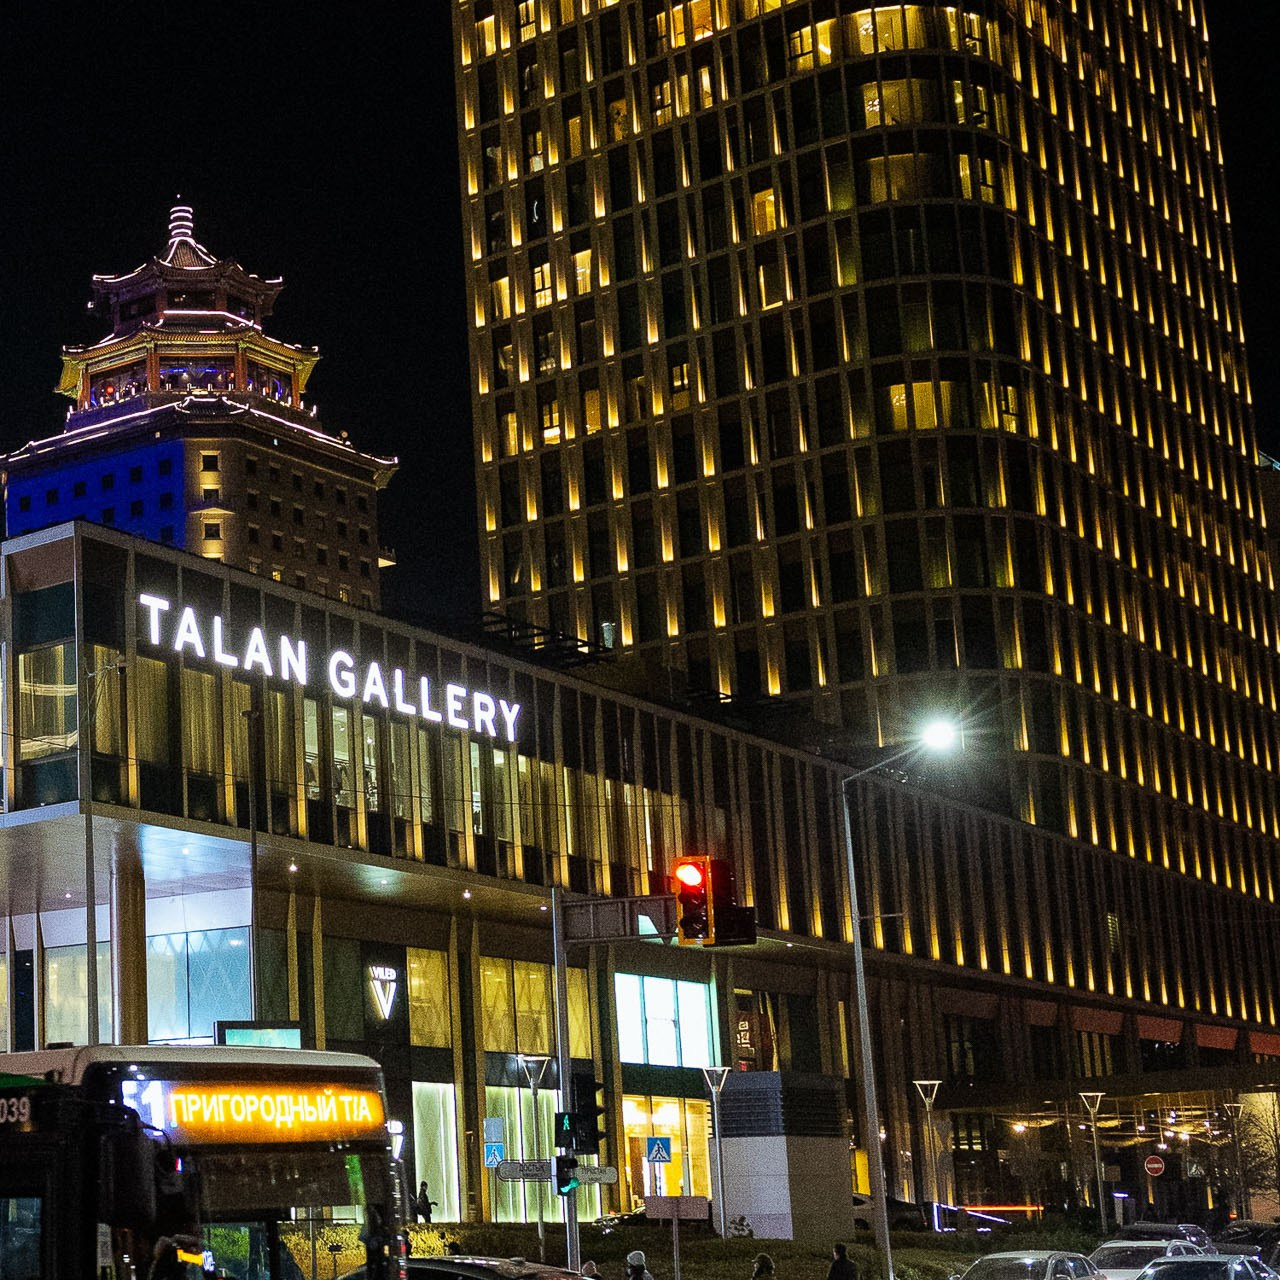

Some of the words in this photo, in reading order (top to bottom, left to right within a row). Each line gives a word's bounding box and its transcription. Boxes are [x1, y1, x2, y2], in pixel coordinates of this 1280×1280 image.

[139, 593, 307, 686] TALAN
[328, 650, 521, 744] GALLERY
[171, 1088, 338, 1128] ПРИГОРОДНЫЙ
